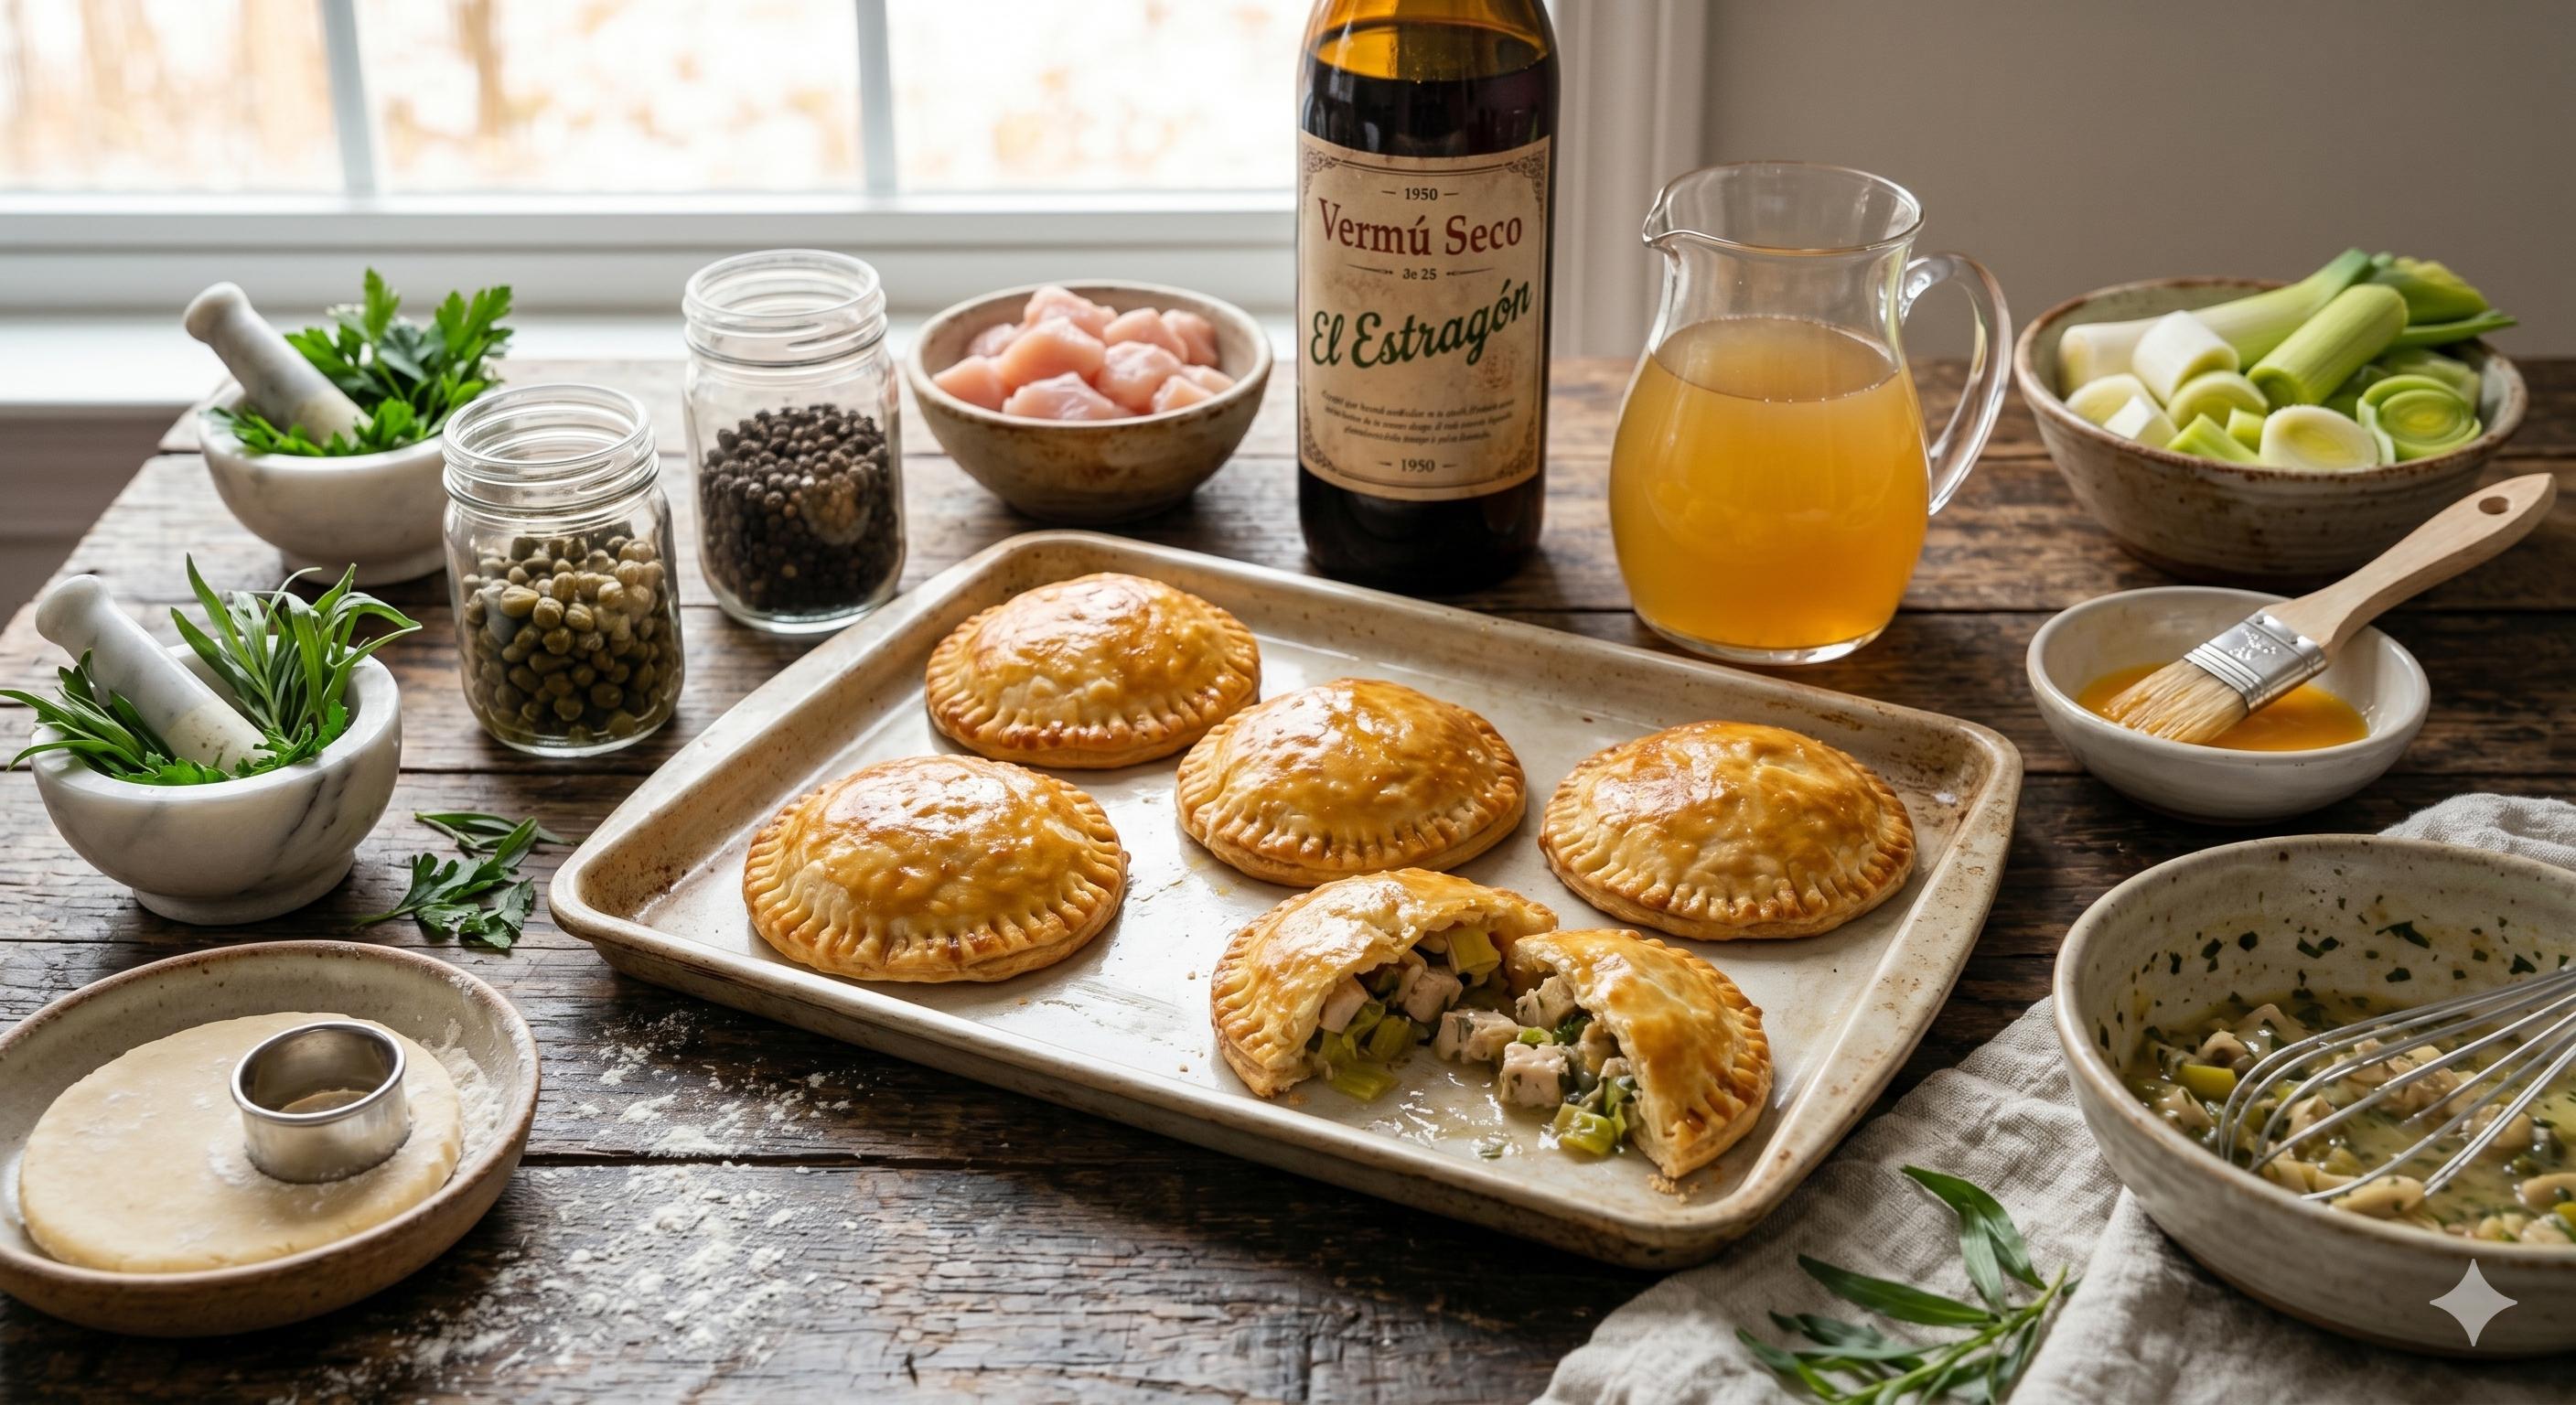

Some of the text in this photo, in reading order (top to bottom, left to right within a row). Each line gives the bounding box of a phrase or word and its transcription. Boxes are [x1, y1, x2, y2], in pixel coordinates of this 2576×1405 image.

[1405, 188, 1438, 200] 1950
[1318, 197, 1522, 256] Vermú Seco
[1421, 269, 1437, 280] 25
[1311, 278, 1532, 369] El Estragón
[1401, 458, 1435, 472] 1950
